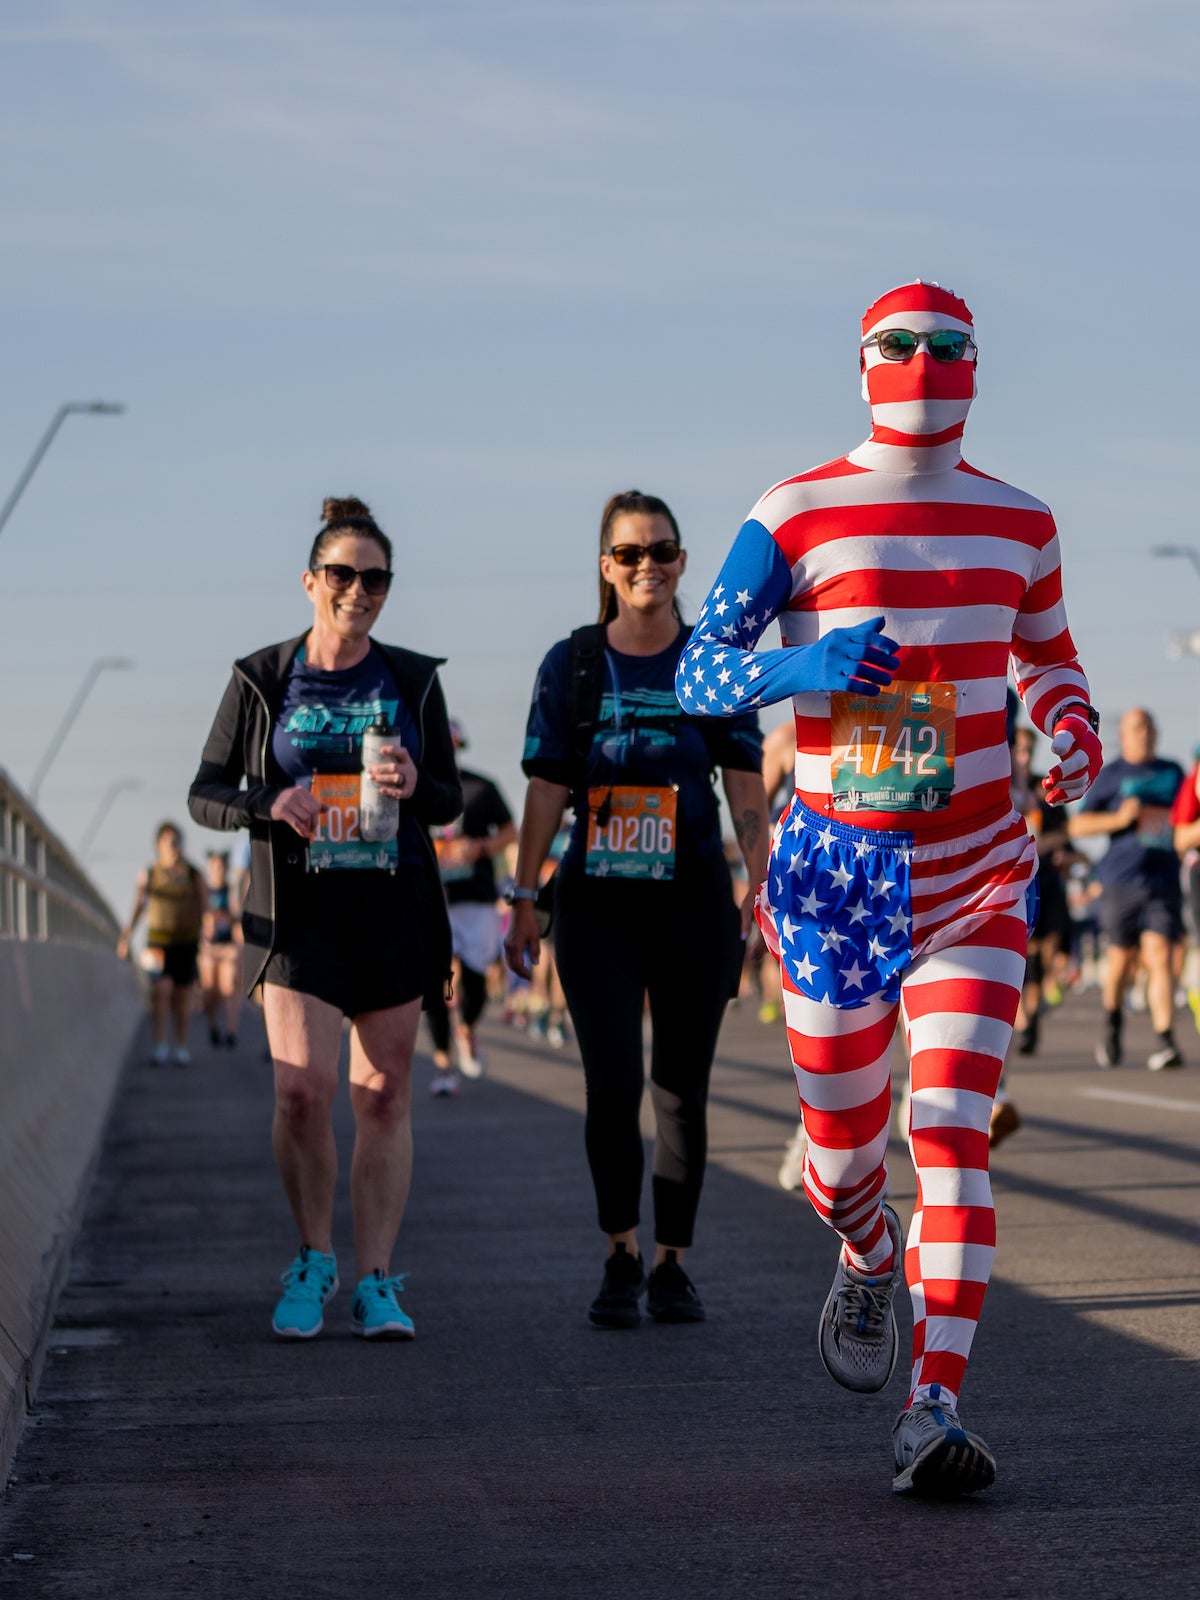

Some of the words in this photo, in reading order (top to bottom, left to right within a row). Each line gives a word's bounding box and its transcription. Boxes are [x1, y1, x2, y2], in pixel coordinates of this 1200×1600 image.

[843, 725, 938, 776] 4742
[891, 791, 915, 801] LIMITS
[313, 806, 361, 842] 102
[591, 815, 673, 854] 10206
